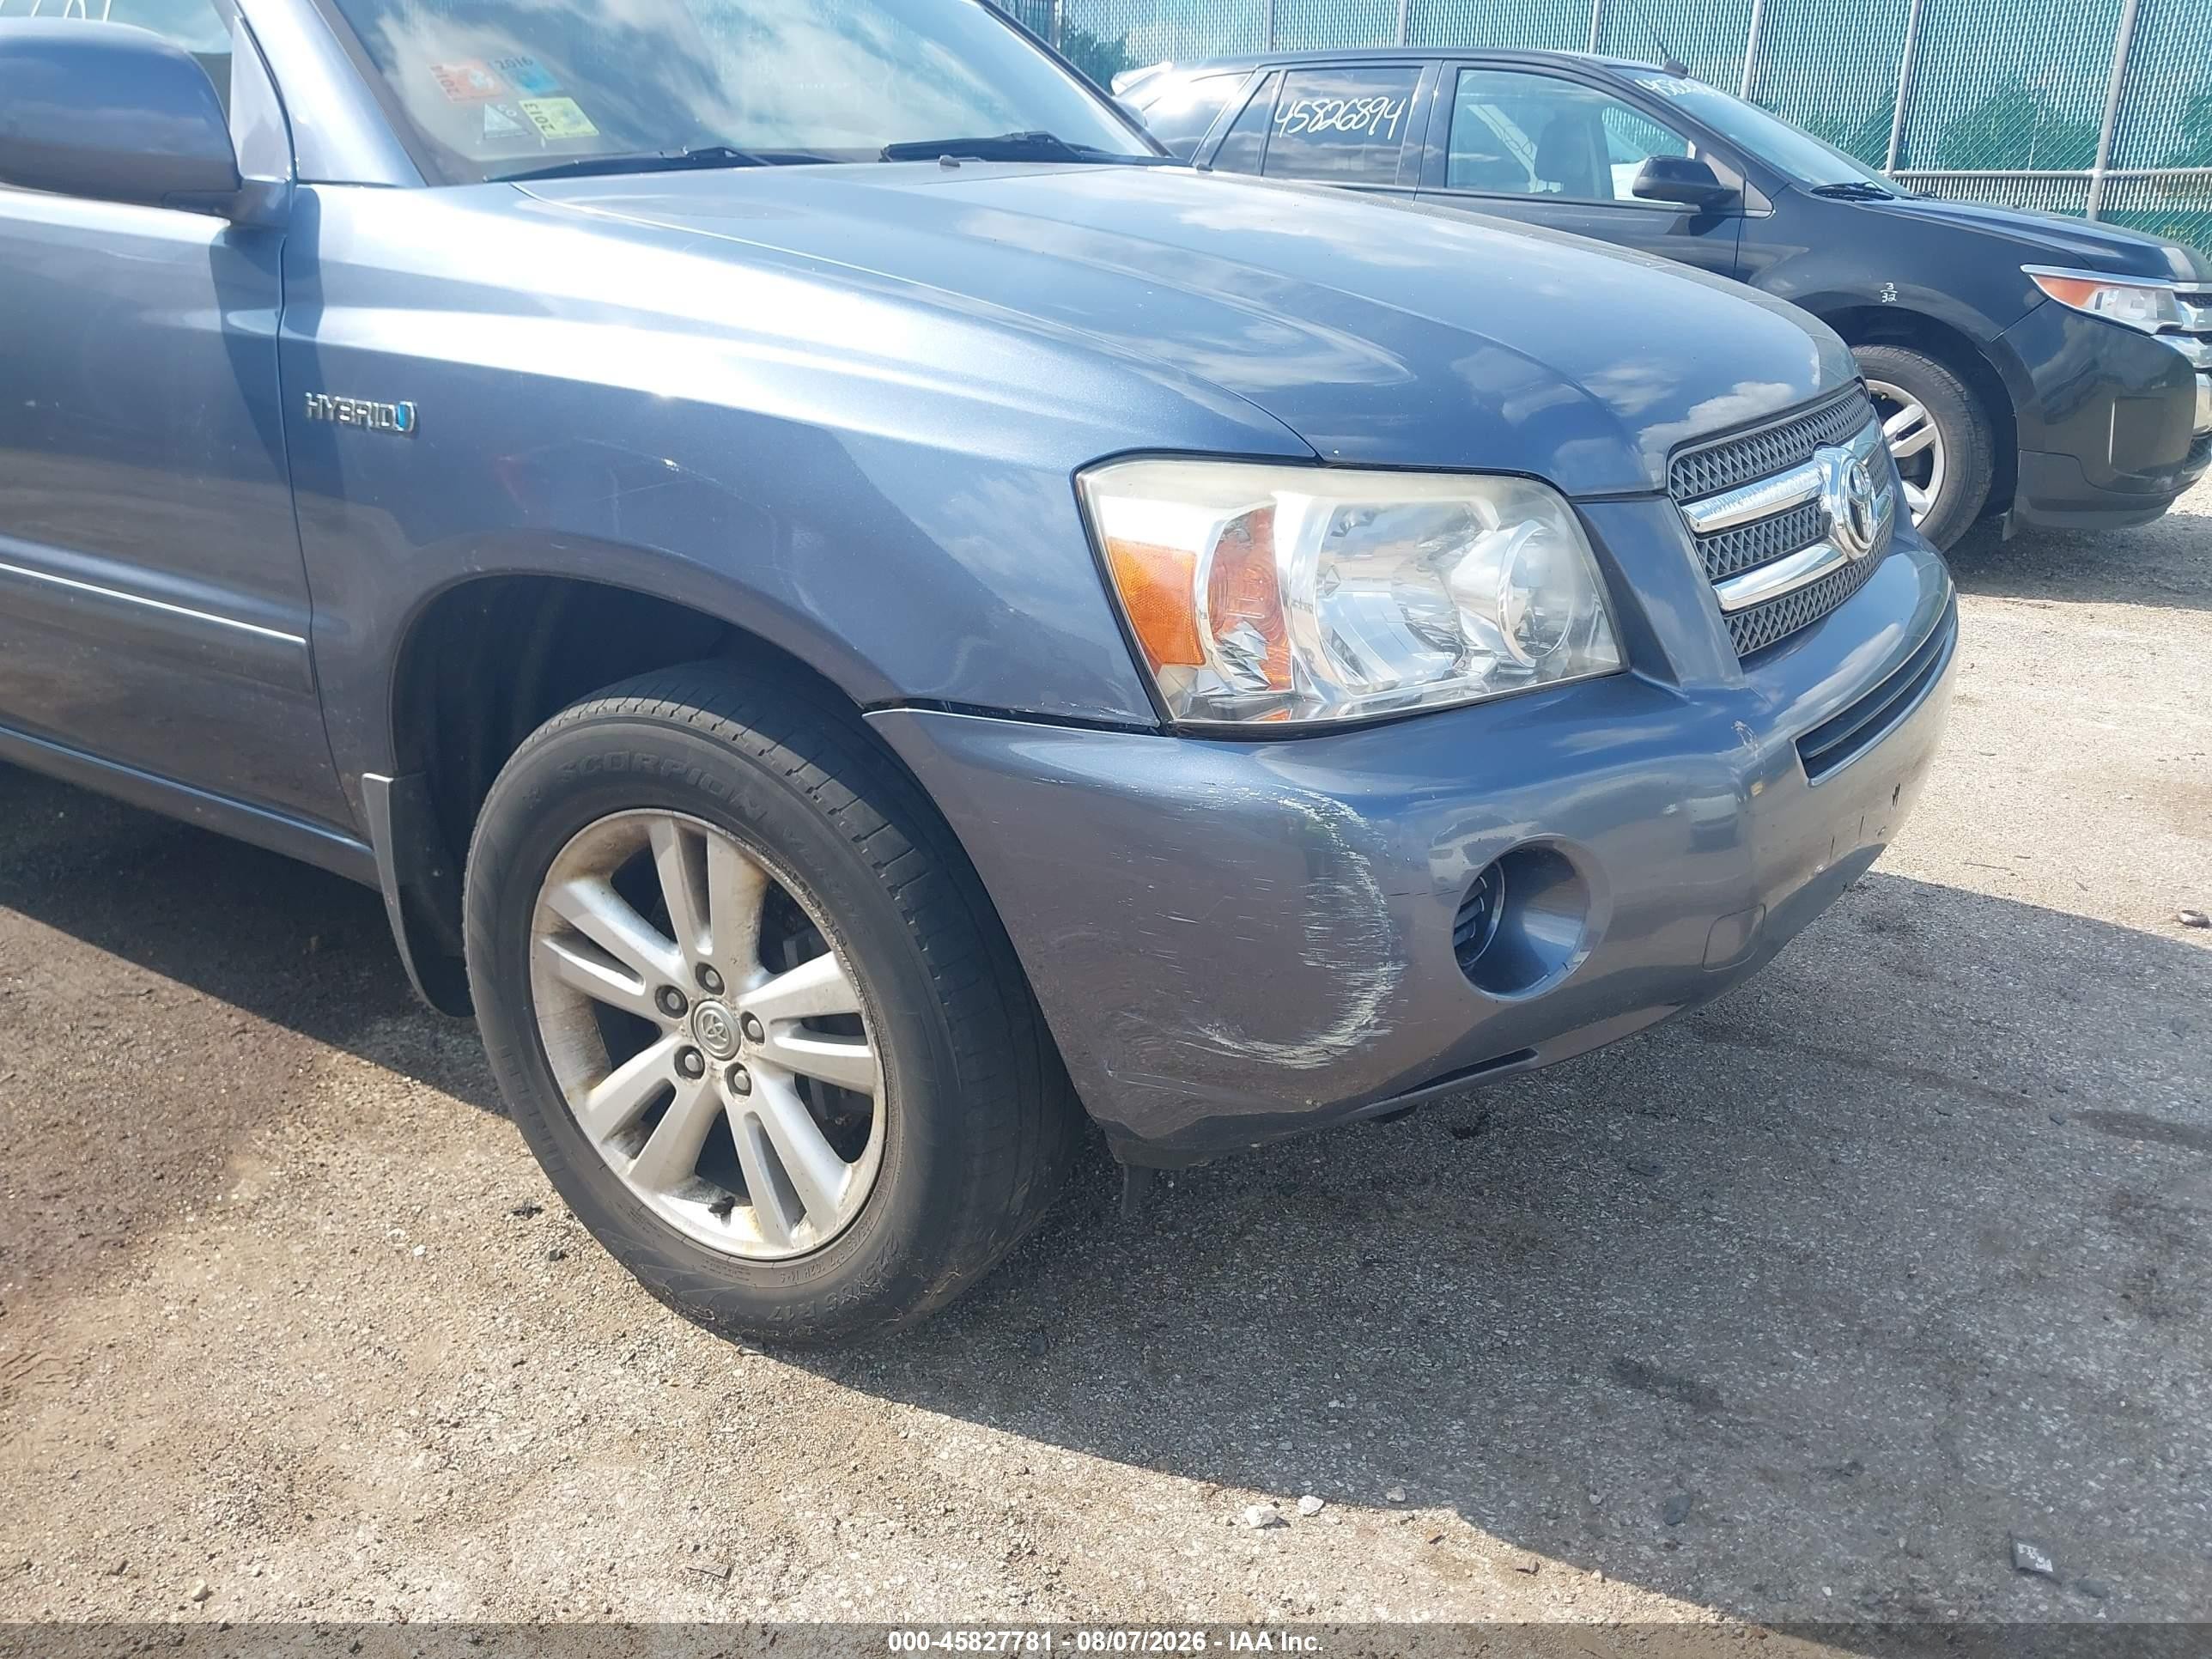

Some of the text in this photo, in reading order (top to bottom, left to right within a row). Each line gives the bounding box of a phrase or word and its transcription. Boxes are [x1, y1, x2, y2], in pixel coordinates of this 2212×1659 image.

[498, 56, 535, 71] 2016
[523, 102, 556, 133] 2013
[1273, 96, 1407, 140] 45826894
[305, 392, 398, 431] HYBRID
[557, 750, 769, 822] SCORPION
